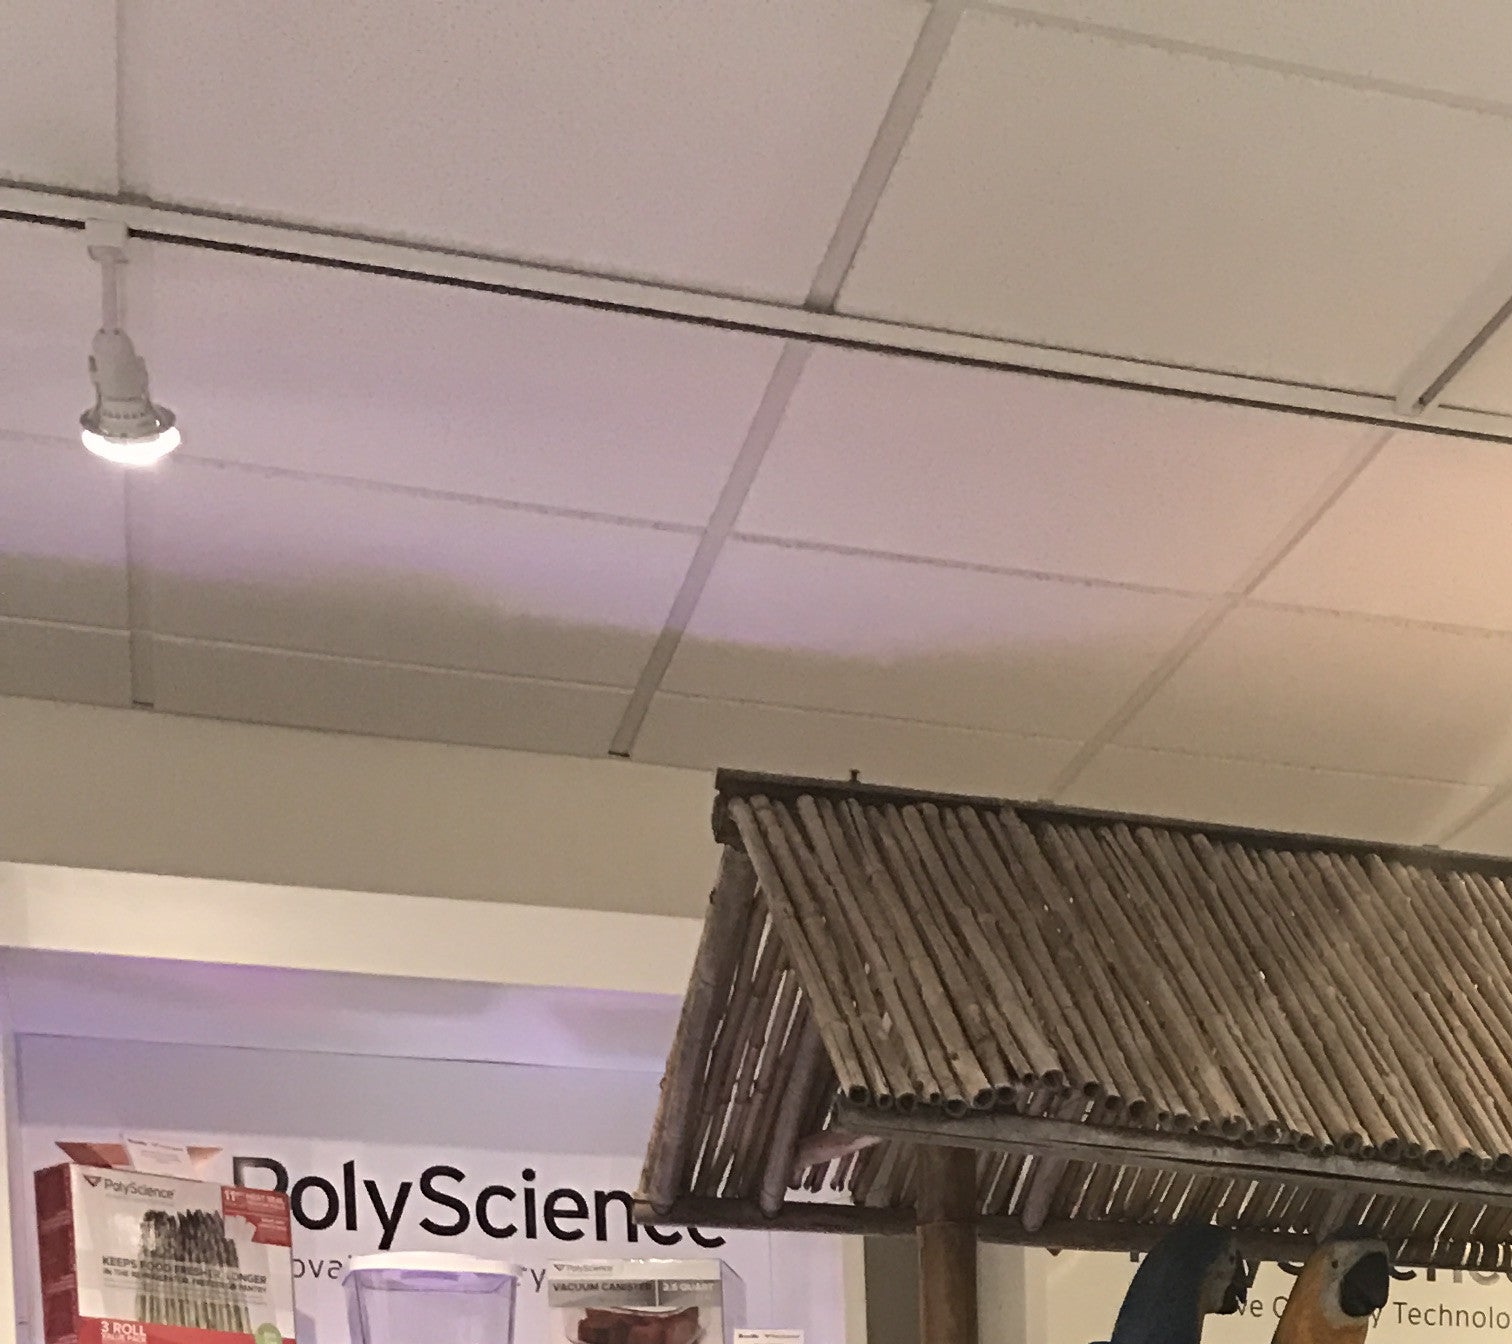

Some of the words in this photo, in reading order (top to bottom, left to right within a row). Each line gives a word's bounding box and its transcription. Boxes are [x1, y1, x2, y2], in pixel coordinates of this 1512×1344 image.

[553, 1282, 599, 1292] VACUUM
[100, 1320, 109, 1333] 3
[112, 1321, 147, 1337] ROLL
